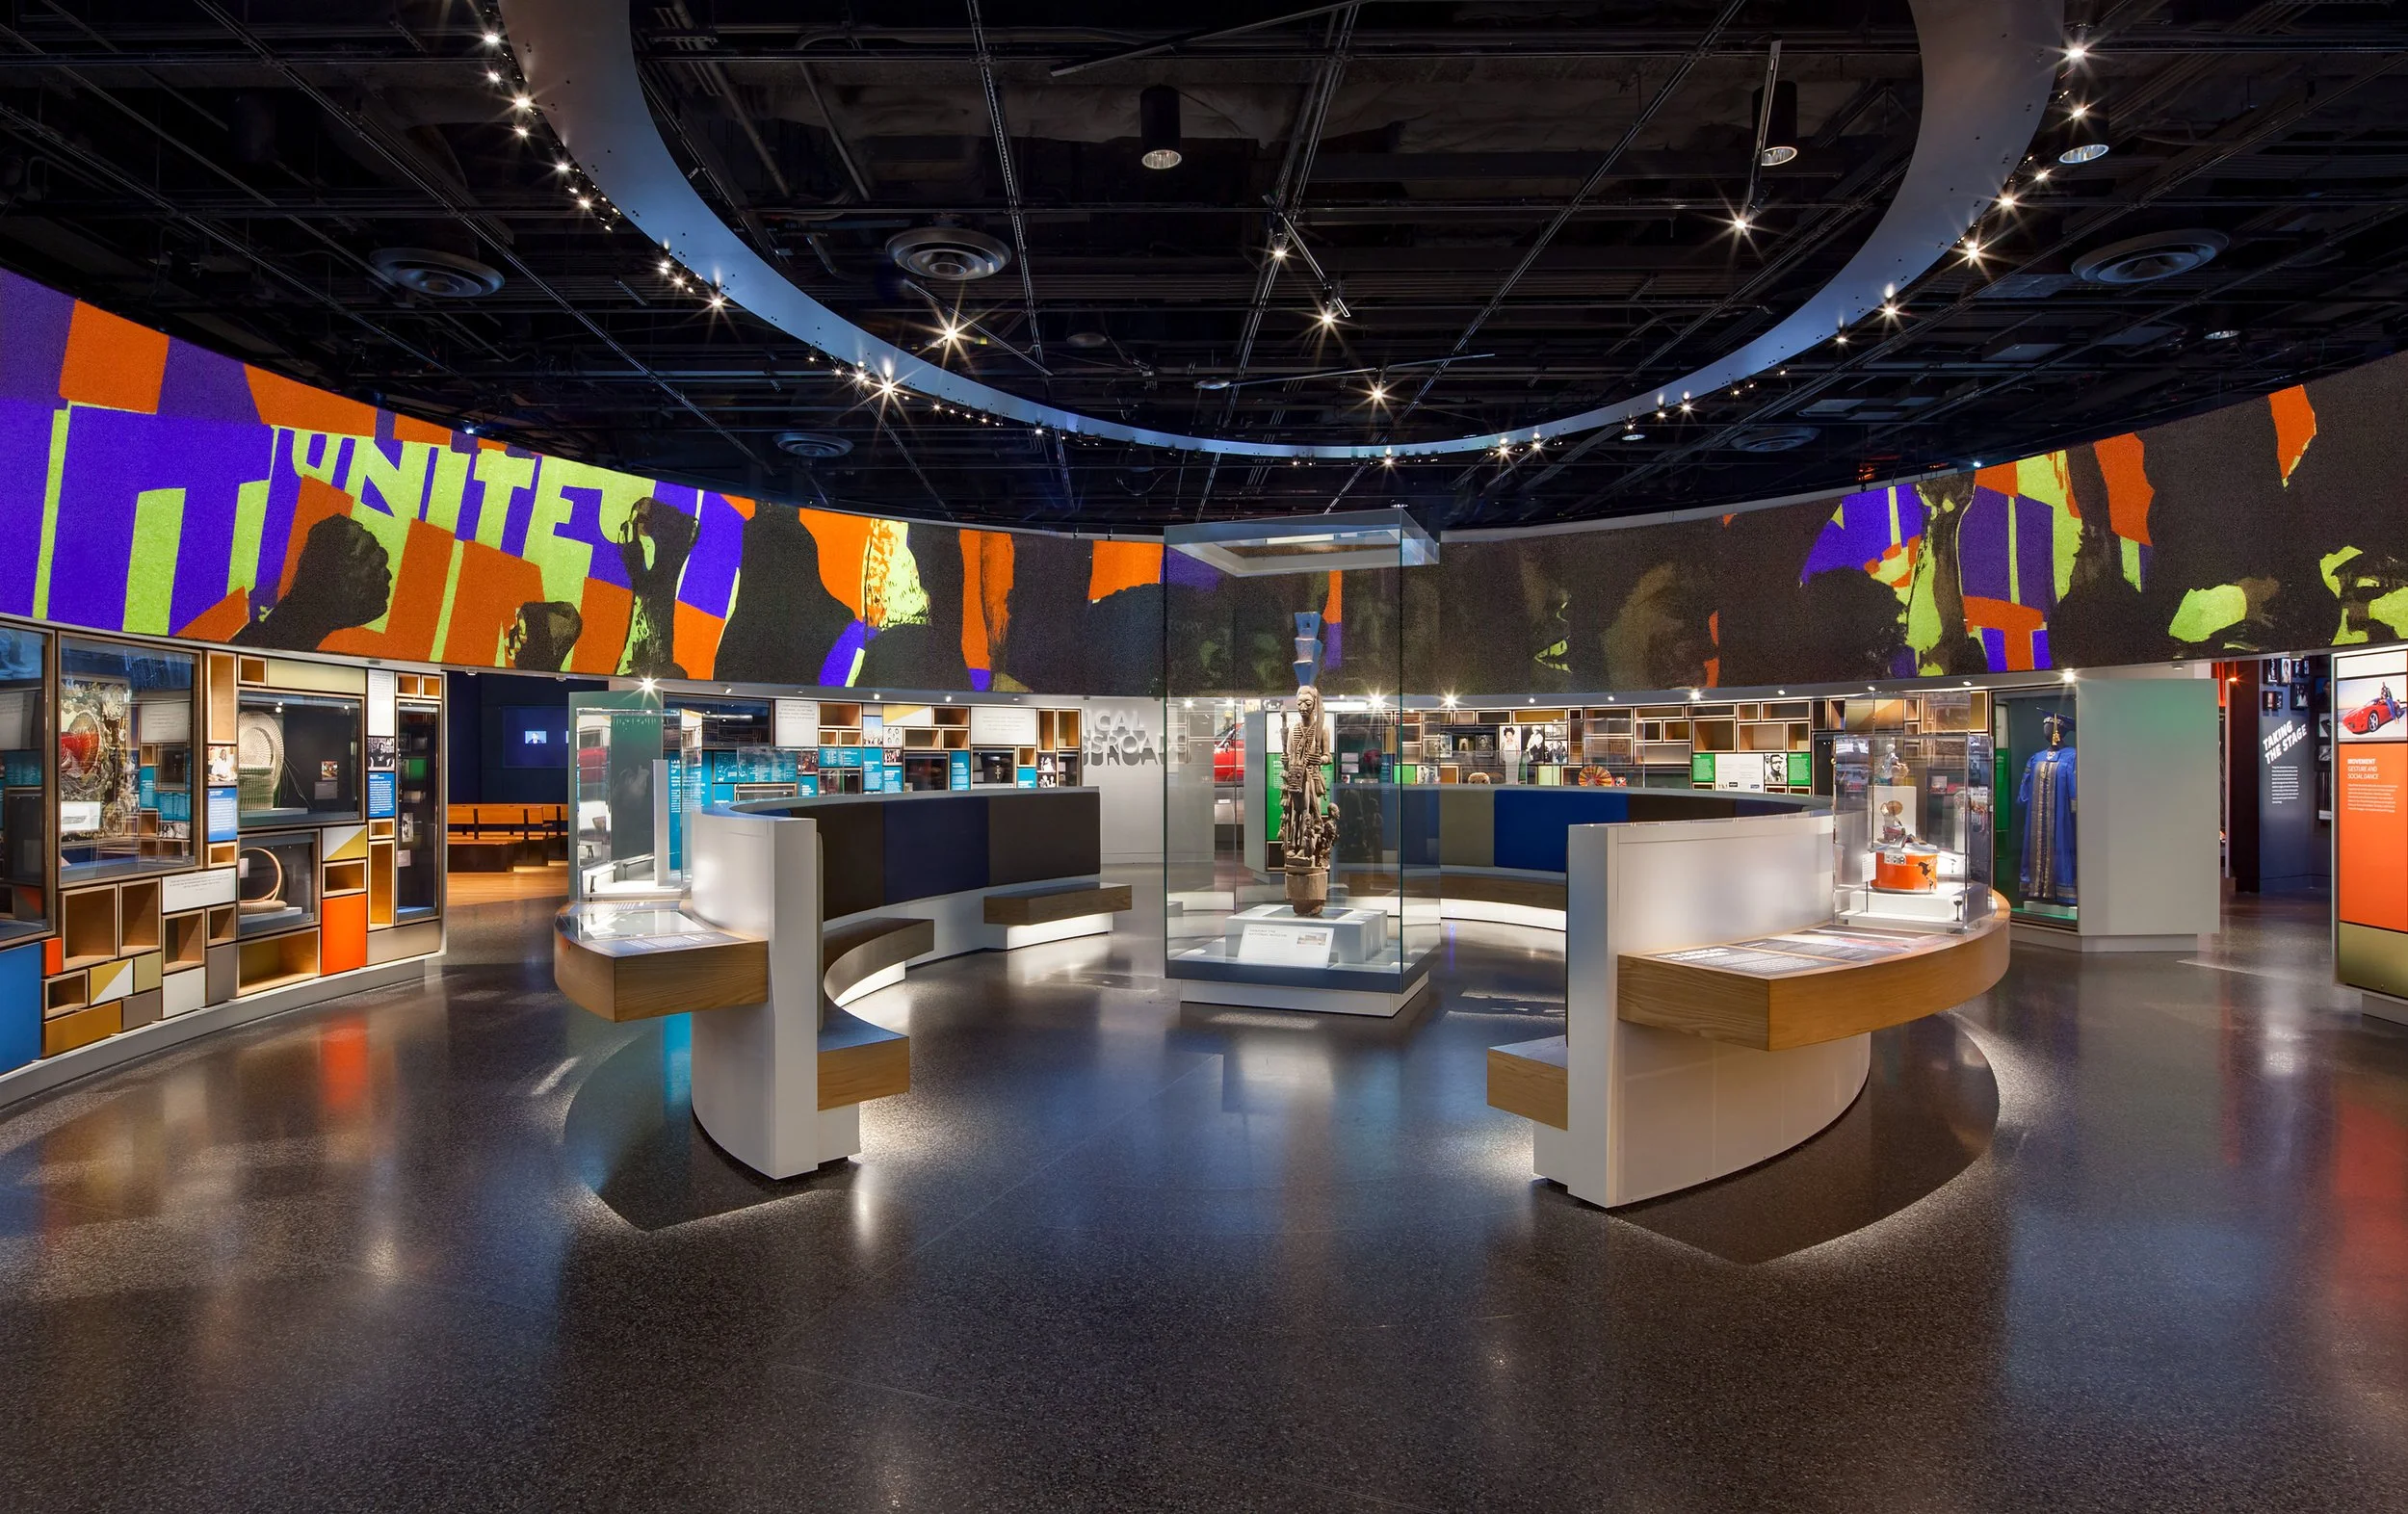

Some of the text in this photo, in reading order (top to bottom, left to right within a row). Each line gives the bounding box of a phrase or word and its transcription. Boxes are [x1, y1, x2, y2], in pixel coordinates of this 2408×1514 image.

[2263, 719, 2293, 751] TAKING
[2264, 723, 2308, 765] THE STAGE
